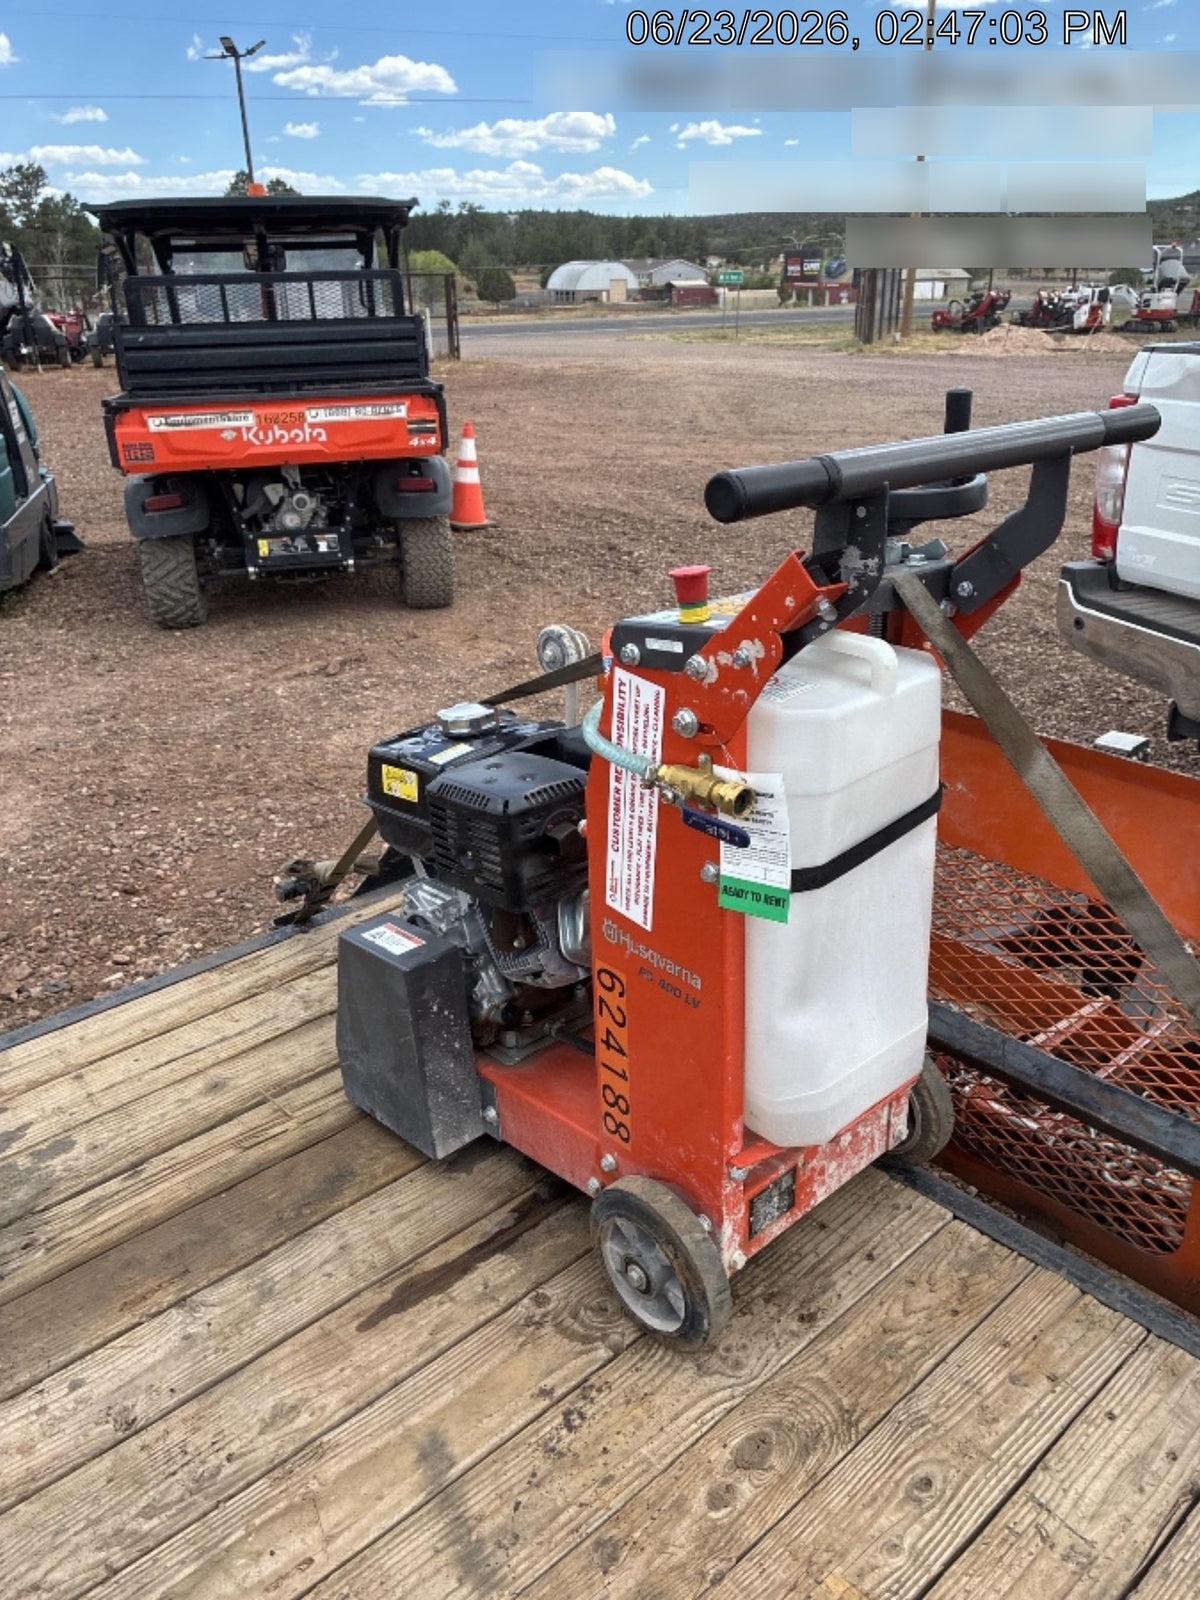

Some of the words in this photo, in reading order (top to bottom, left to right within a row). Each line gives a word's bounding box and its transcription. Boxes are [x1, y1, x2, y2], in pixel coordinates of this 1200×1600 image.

[242, 424, 327, 445] Kubota
[408, 436, 437, 447] 4x4
[612, 786, 621, 852] CUSTOMER
[750, 887, 762, 902] TO
[763, 893, 787, 910] RENT
[618, 933, 701, 990] Husqvarna
[597, 968, 631, 1145] 624188
